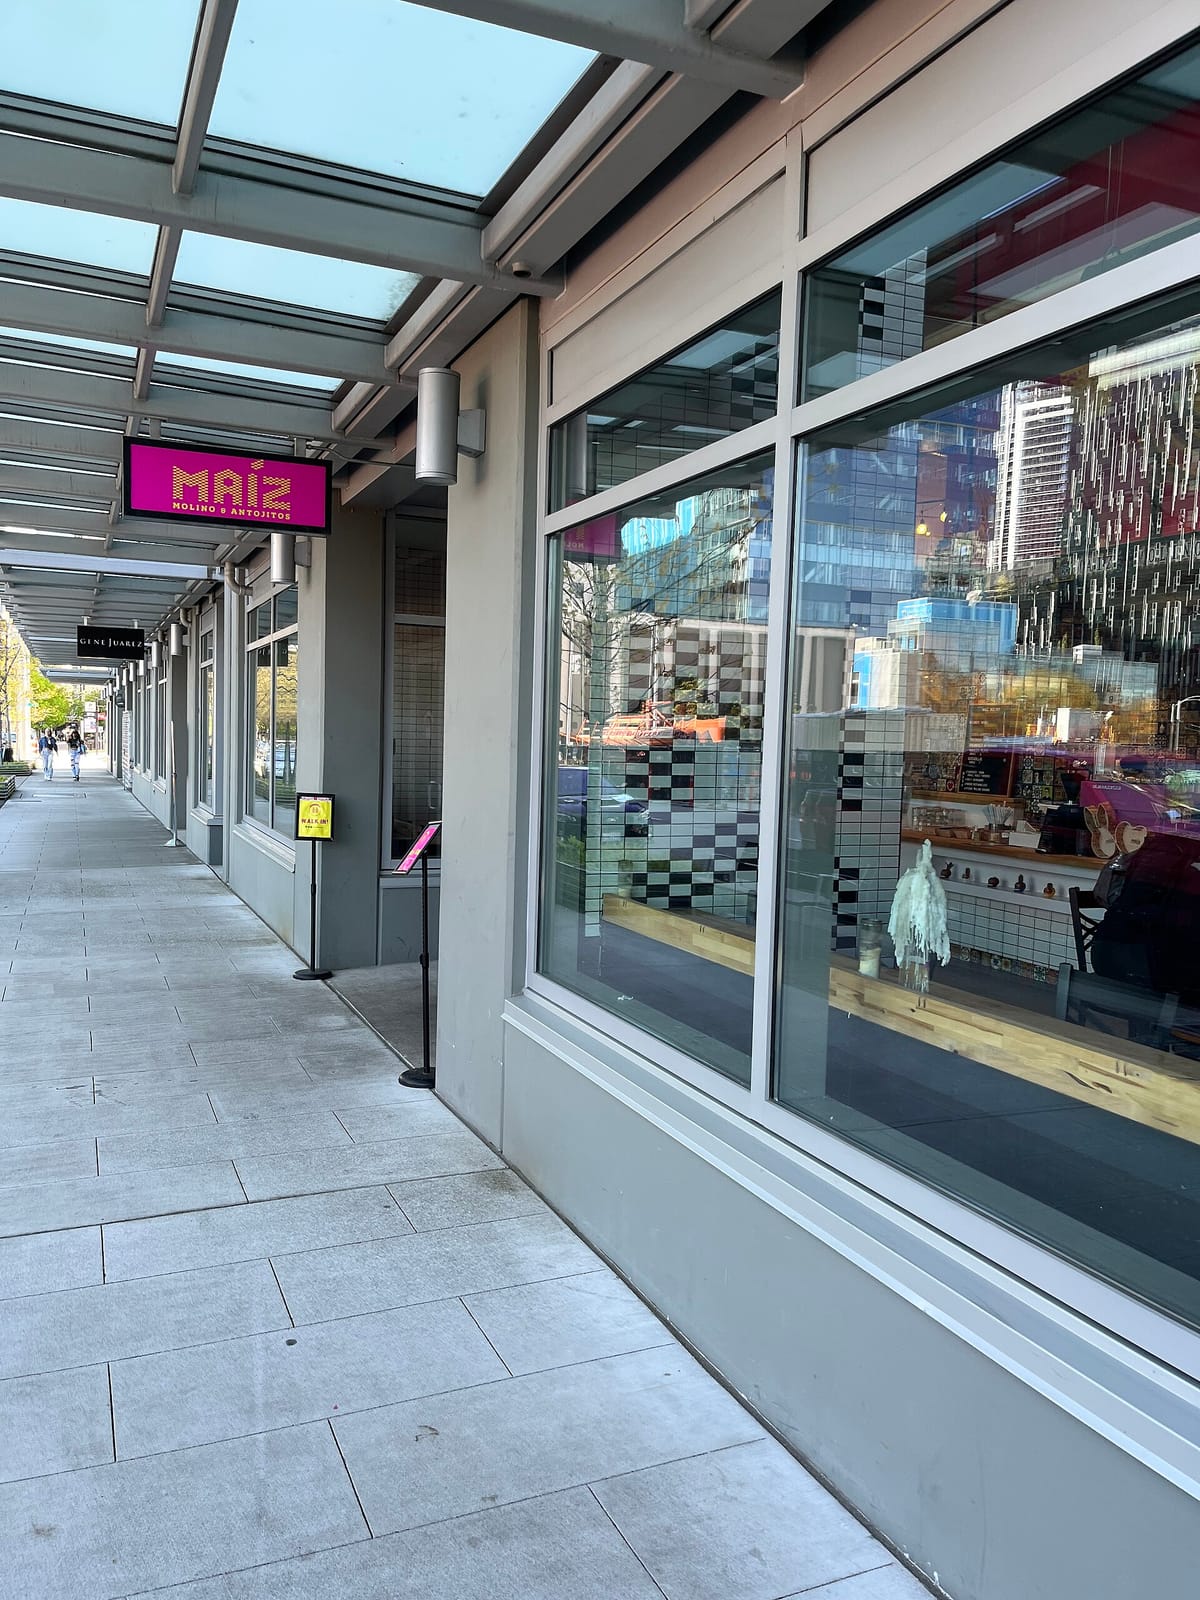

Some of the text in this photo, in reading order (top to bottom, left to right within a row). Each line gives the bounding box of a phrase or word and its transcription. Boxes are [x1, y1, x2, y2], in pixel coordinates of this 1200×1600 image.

[172, 459, 291, 511] MAÍZ
[172, 502, 215, 513] MOLINO
[231, 508, 291, 520] ANTOJITOS
[80, 638, 143, 647] GENE JUAREZ
